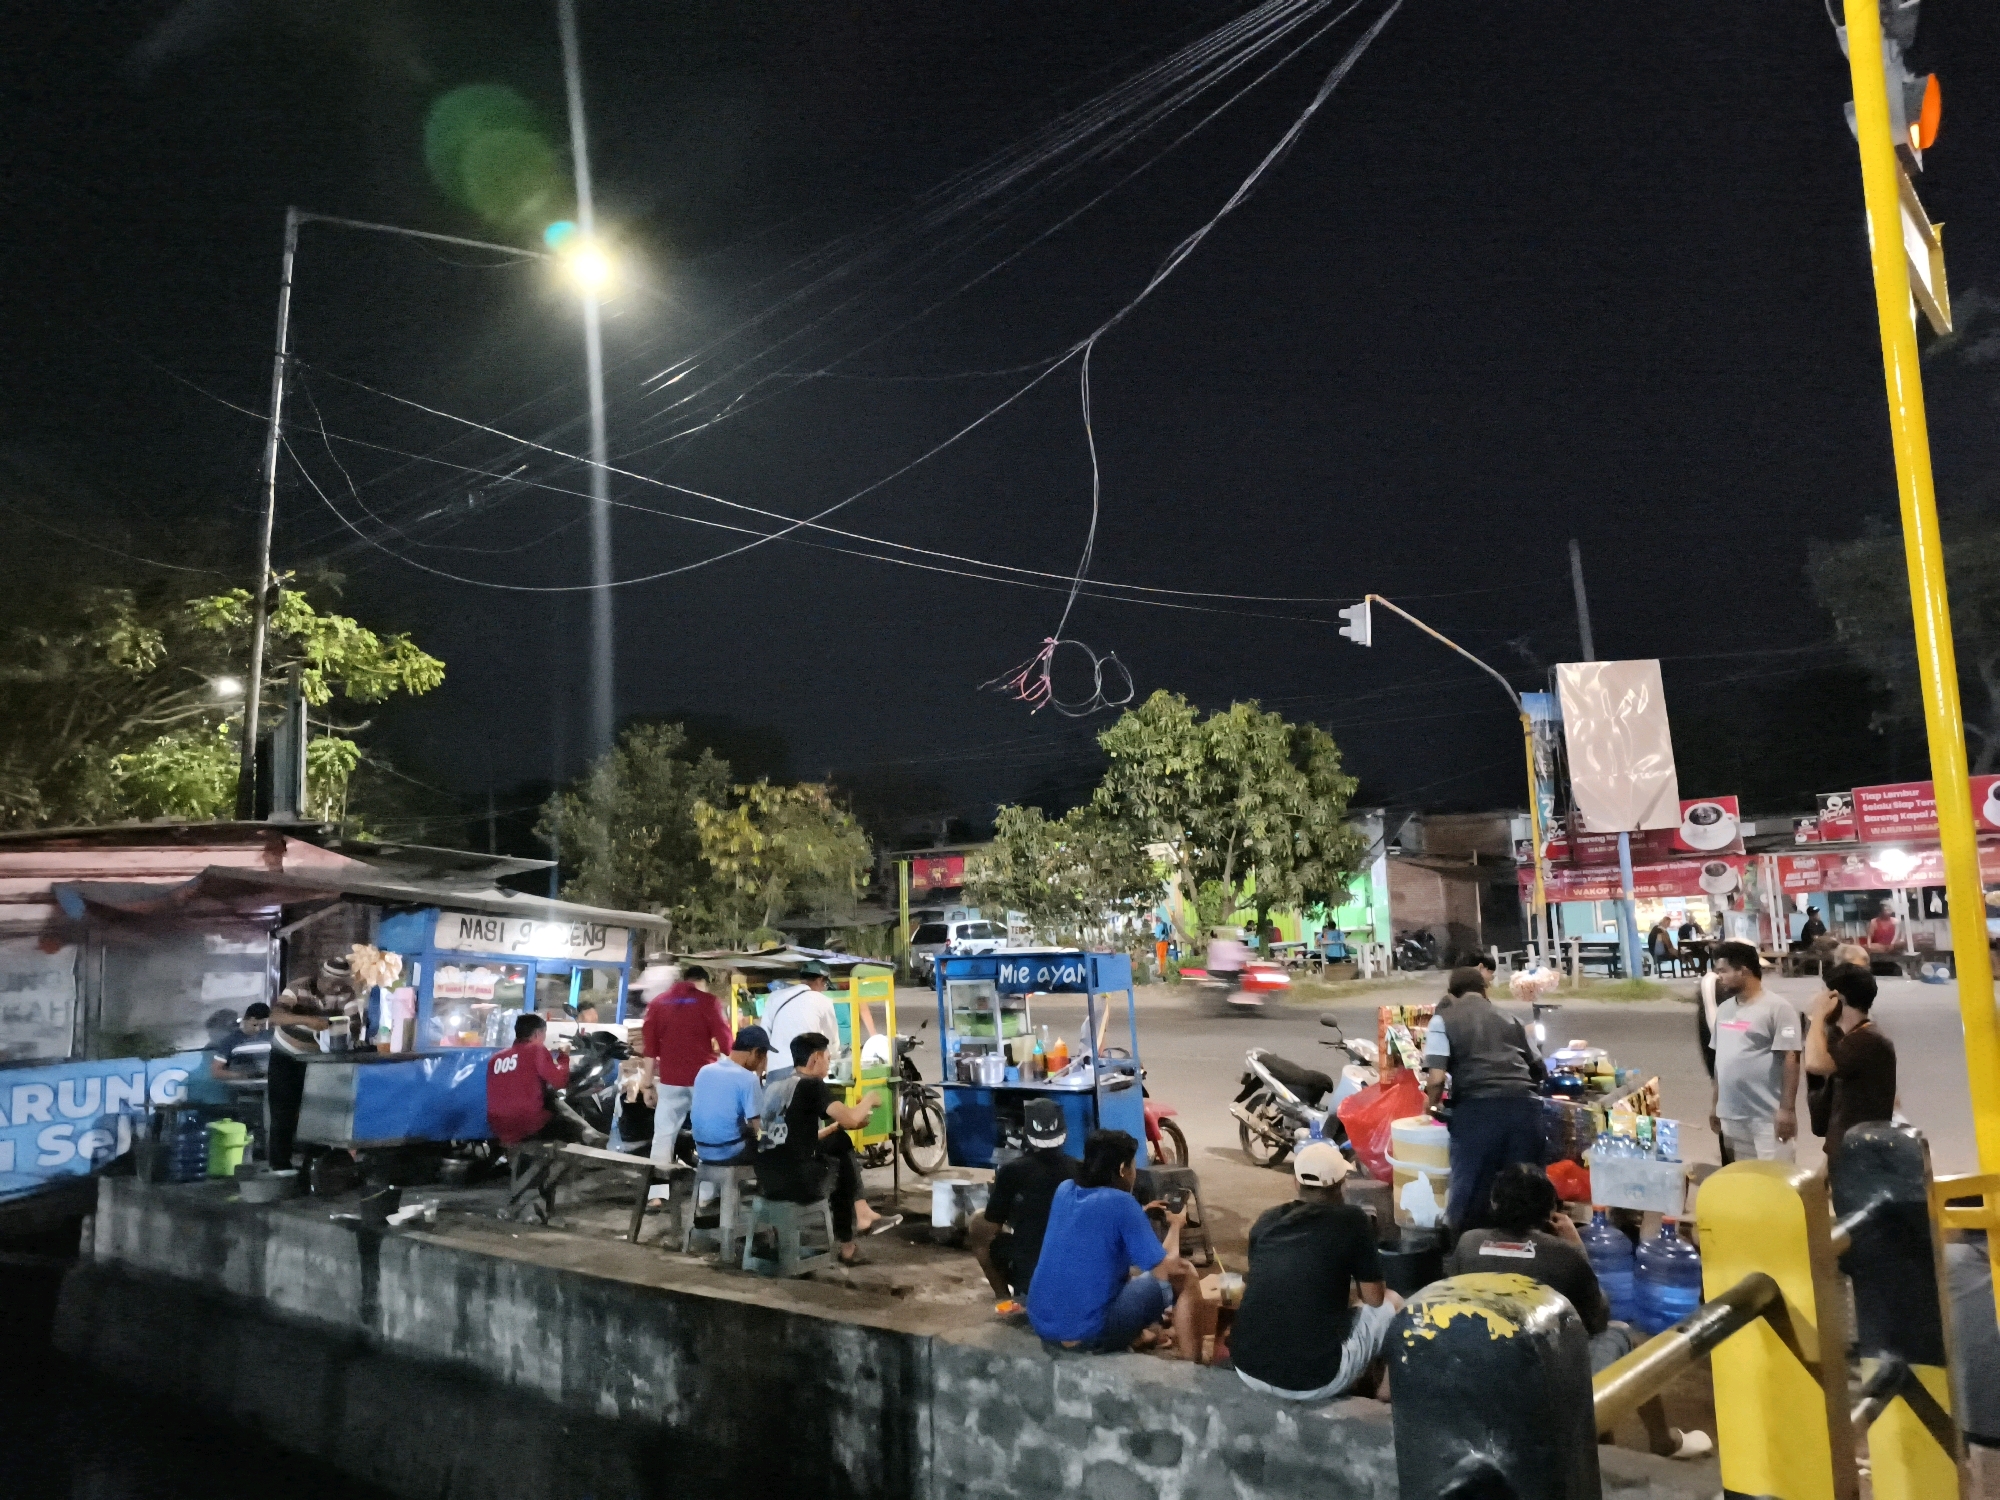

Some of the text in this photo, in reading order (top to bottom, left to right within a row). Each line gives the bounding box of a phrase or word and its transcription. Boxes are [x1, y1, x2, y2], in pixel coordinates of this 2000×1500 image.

[1900, 810, 1929, 820] Kapal
[459, 917, 505, 943] NASI
[1000, 963, 1030, 984] Mie
[493, 1053, 518, 1075] 005
[0, 1067, 190, 1127] RUNG
